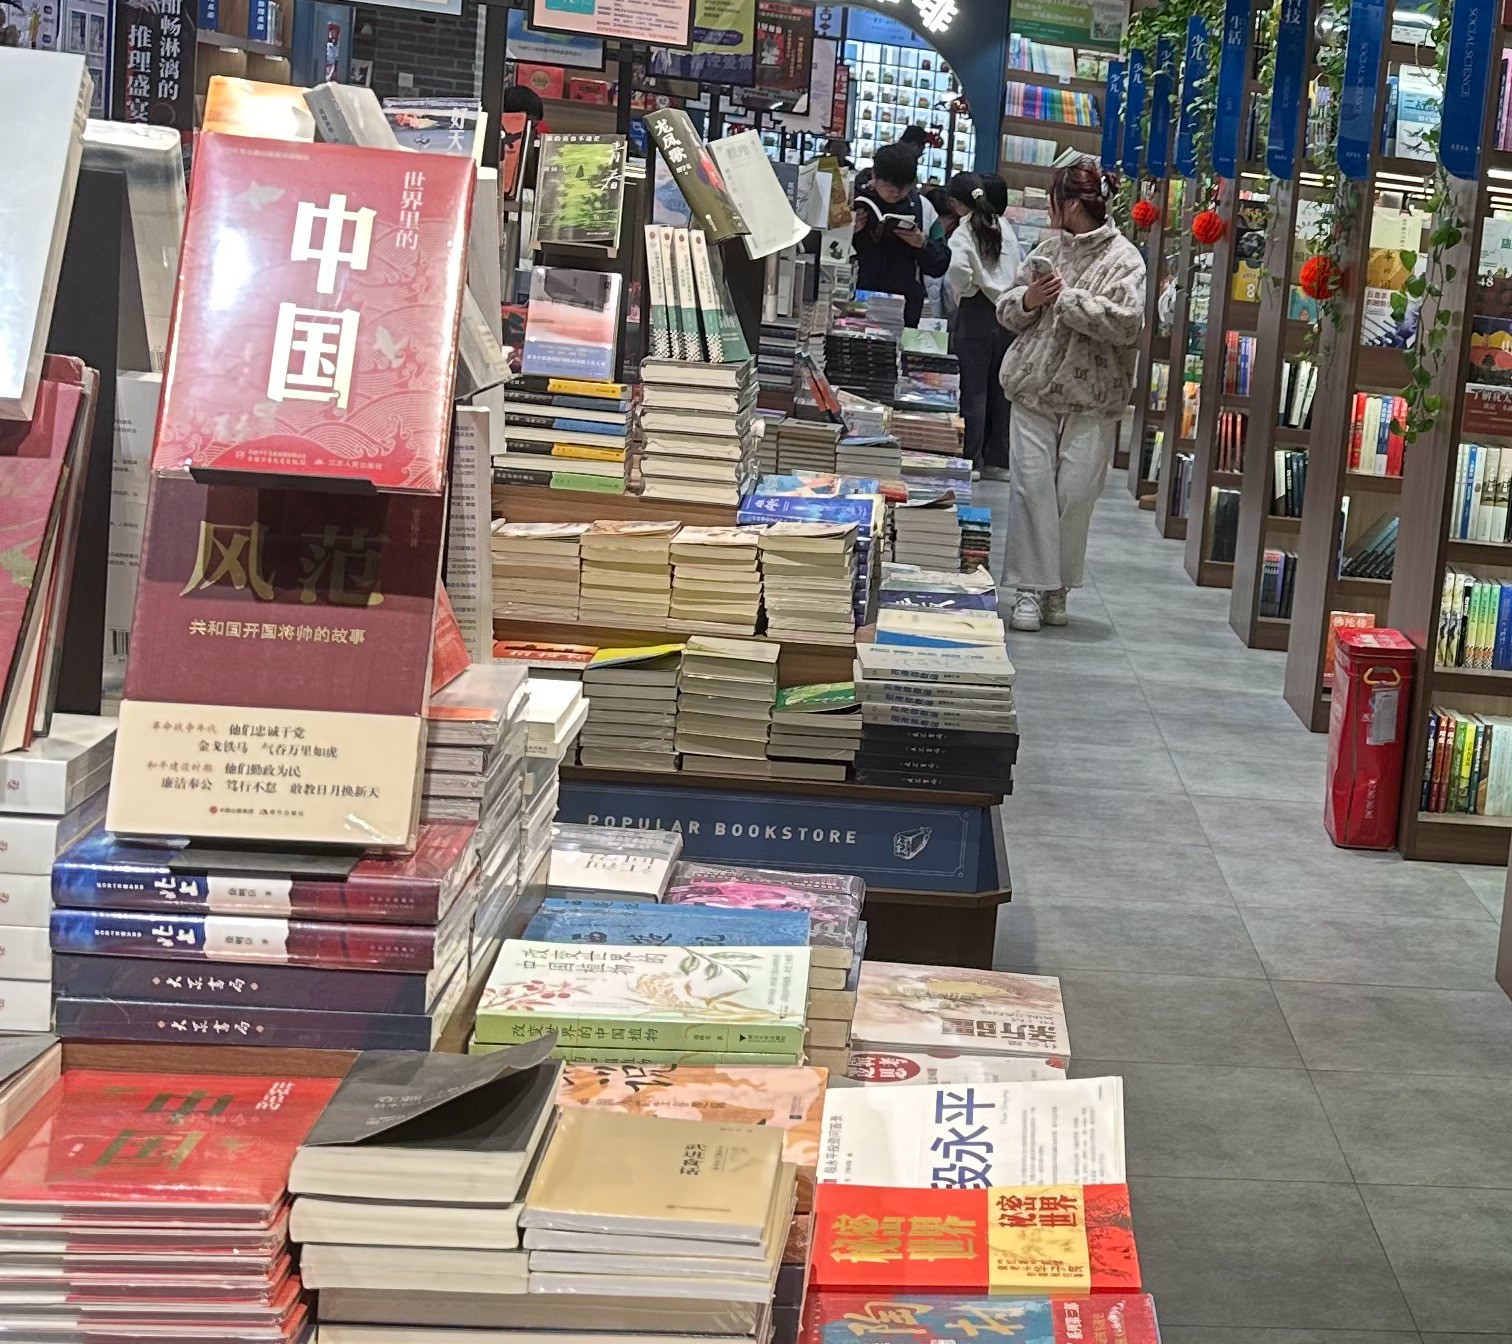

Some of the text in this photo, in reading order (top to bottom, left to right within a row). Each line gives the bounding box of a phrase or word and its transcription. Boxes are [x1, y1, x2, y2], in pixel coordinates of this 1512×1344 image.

[127, 25, 152, 121] 推理盛宴
[396, 170, 424, 250] 世界里的
[267, 193, 377, 410] 中国
[179, 519, 389, 606] 风范
[188, 619, 367, 646] 共和国开国将帅的故事
[229, 723, 306, 740] 他们忠诚于党
[261, 742, 338, 759] 气吞万里如虎
[224, 761, 302, 779] 他们勤政为民
[714, 822, 858, 847] BOOKSTORE
[930, 1087, 996, 1189] 段永平
